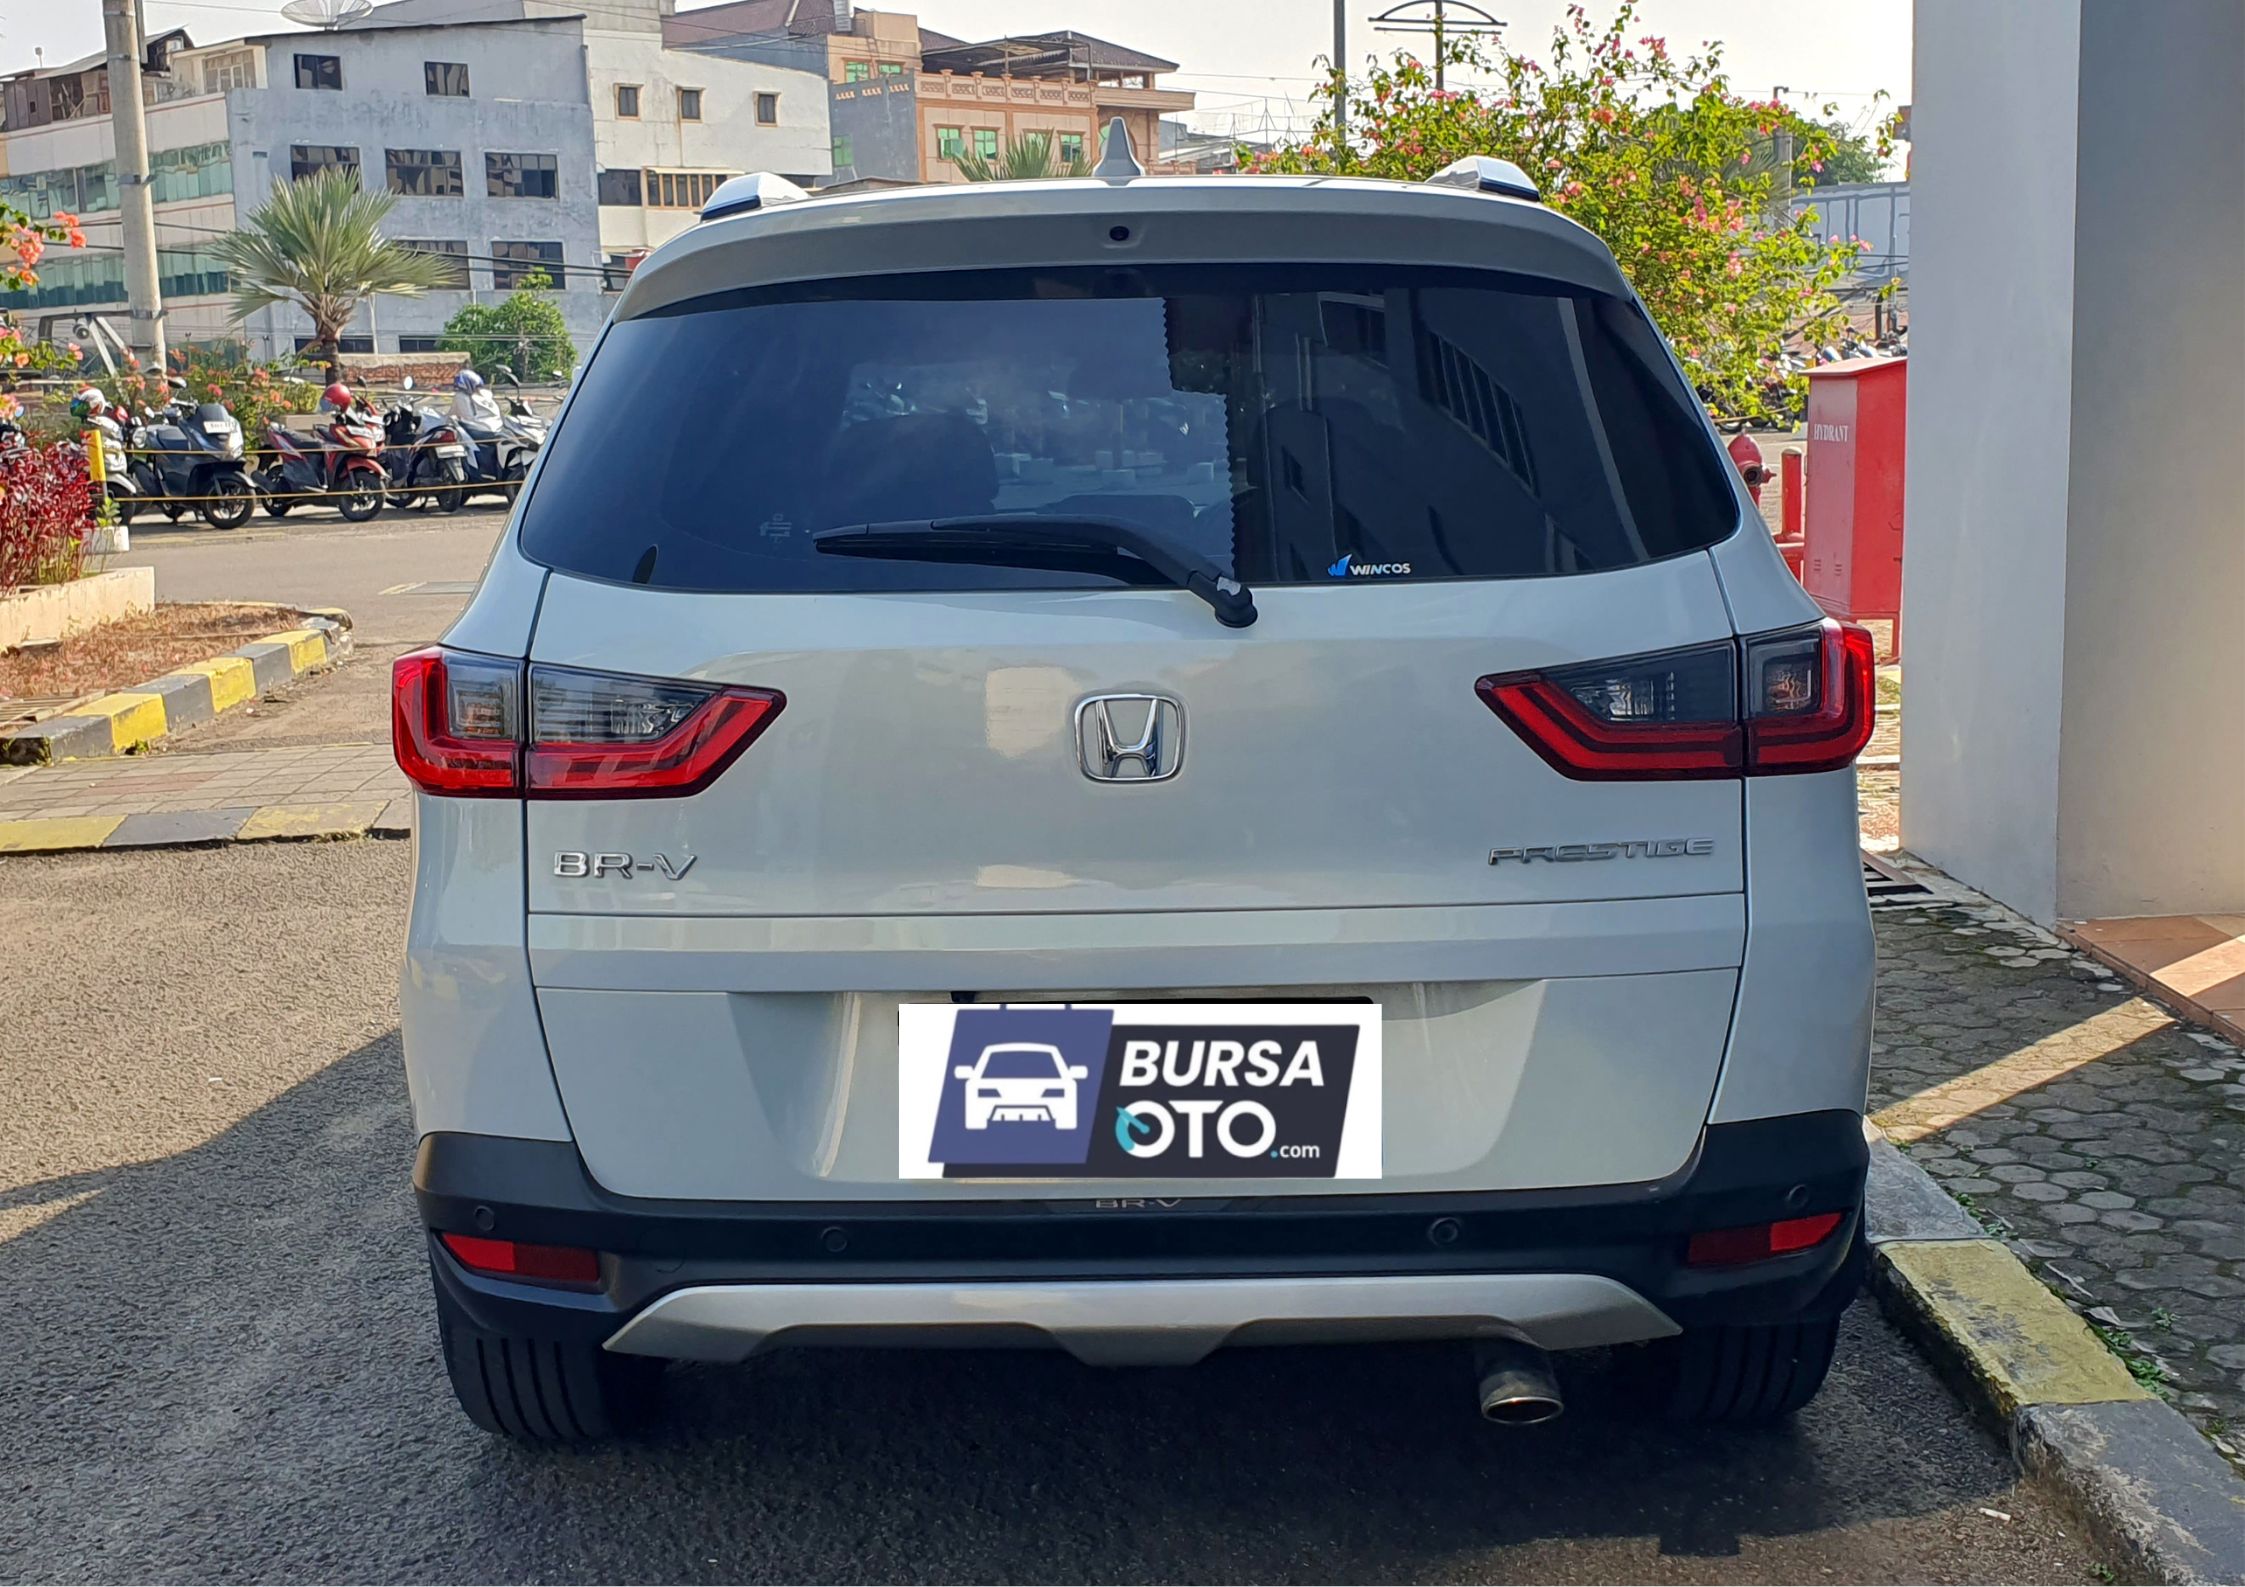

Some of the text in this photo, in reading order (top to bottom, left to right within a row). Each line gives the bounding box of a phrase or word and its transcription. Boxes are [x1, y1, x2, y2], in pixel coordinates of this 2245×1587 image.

[1349, 562, 1411, 576] WINCOS
[554, 851, 698, 881] BR-V
[1488, 837, 1714, 866] PRESTIGE
